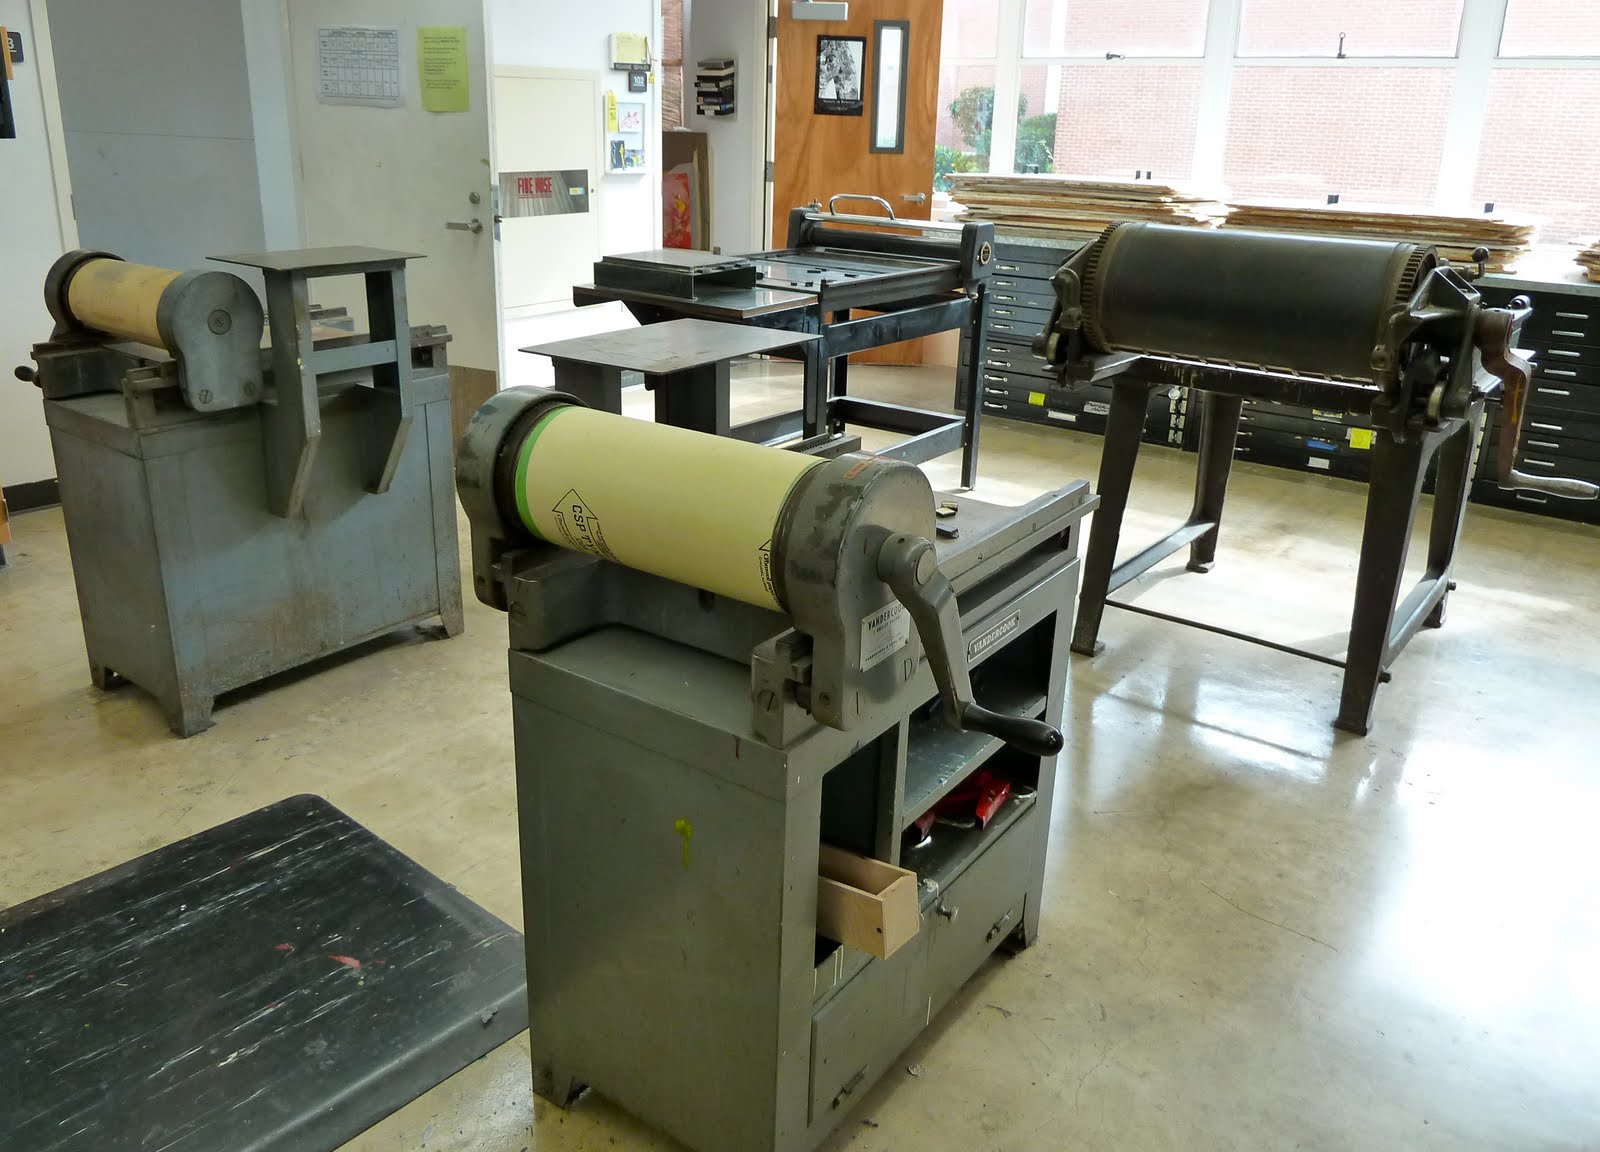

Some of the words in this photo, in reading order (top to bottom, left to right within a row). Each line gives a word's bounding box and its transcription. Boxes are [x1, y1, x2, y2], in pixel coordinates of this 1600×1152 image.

[633, 76, 644, 85] 102
[517, 177, 533, 194] FIRE
[535, 177, 552, 193] HOSE
[572, 505, 586, 532] CSP
[973, 617, 1016, 653] VANDERCOOK
